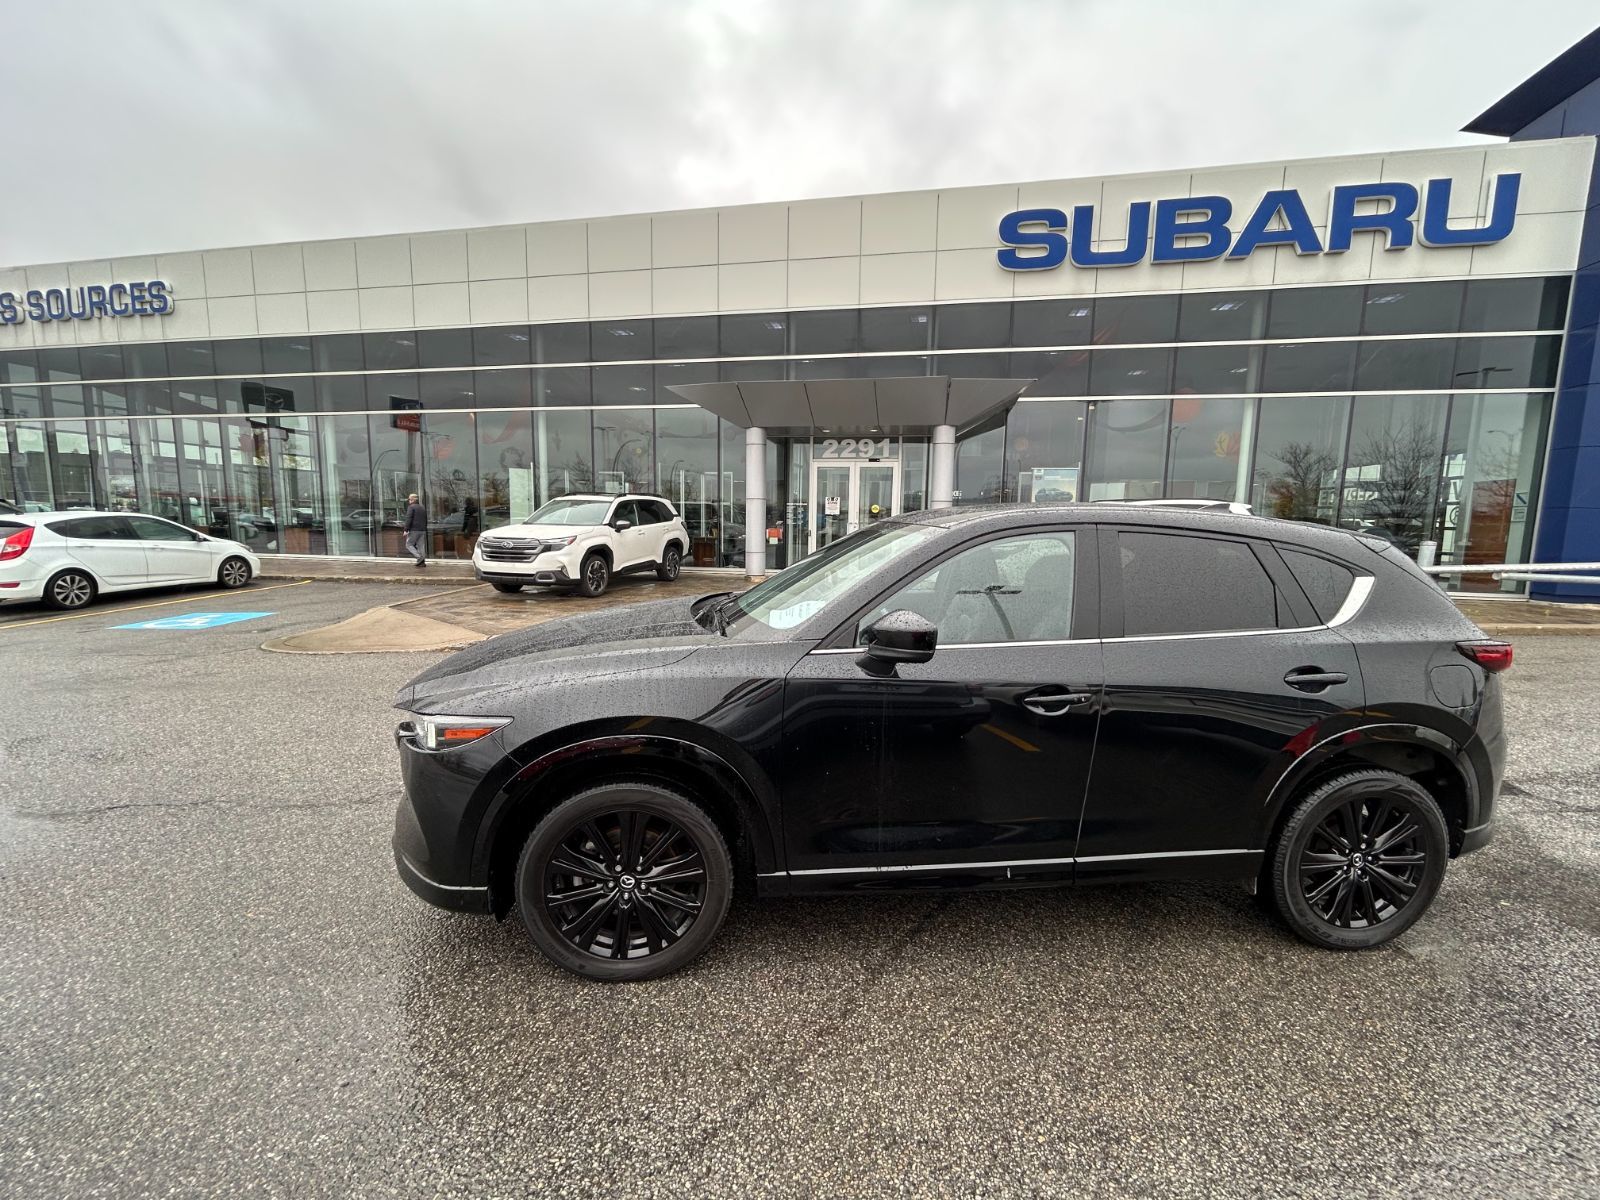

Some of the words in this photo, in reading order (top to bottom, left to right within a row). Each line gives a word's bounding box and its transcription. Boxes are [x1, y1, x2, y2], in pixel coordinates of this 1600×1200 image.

[997, 172, 1522, 271] SUBARU
[26, 280, 171, 321] SOURCES
[822, 438, 891, 458] 2291
